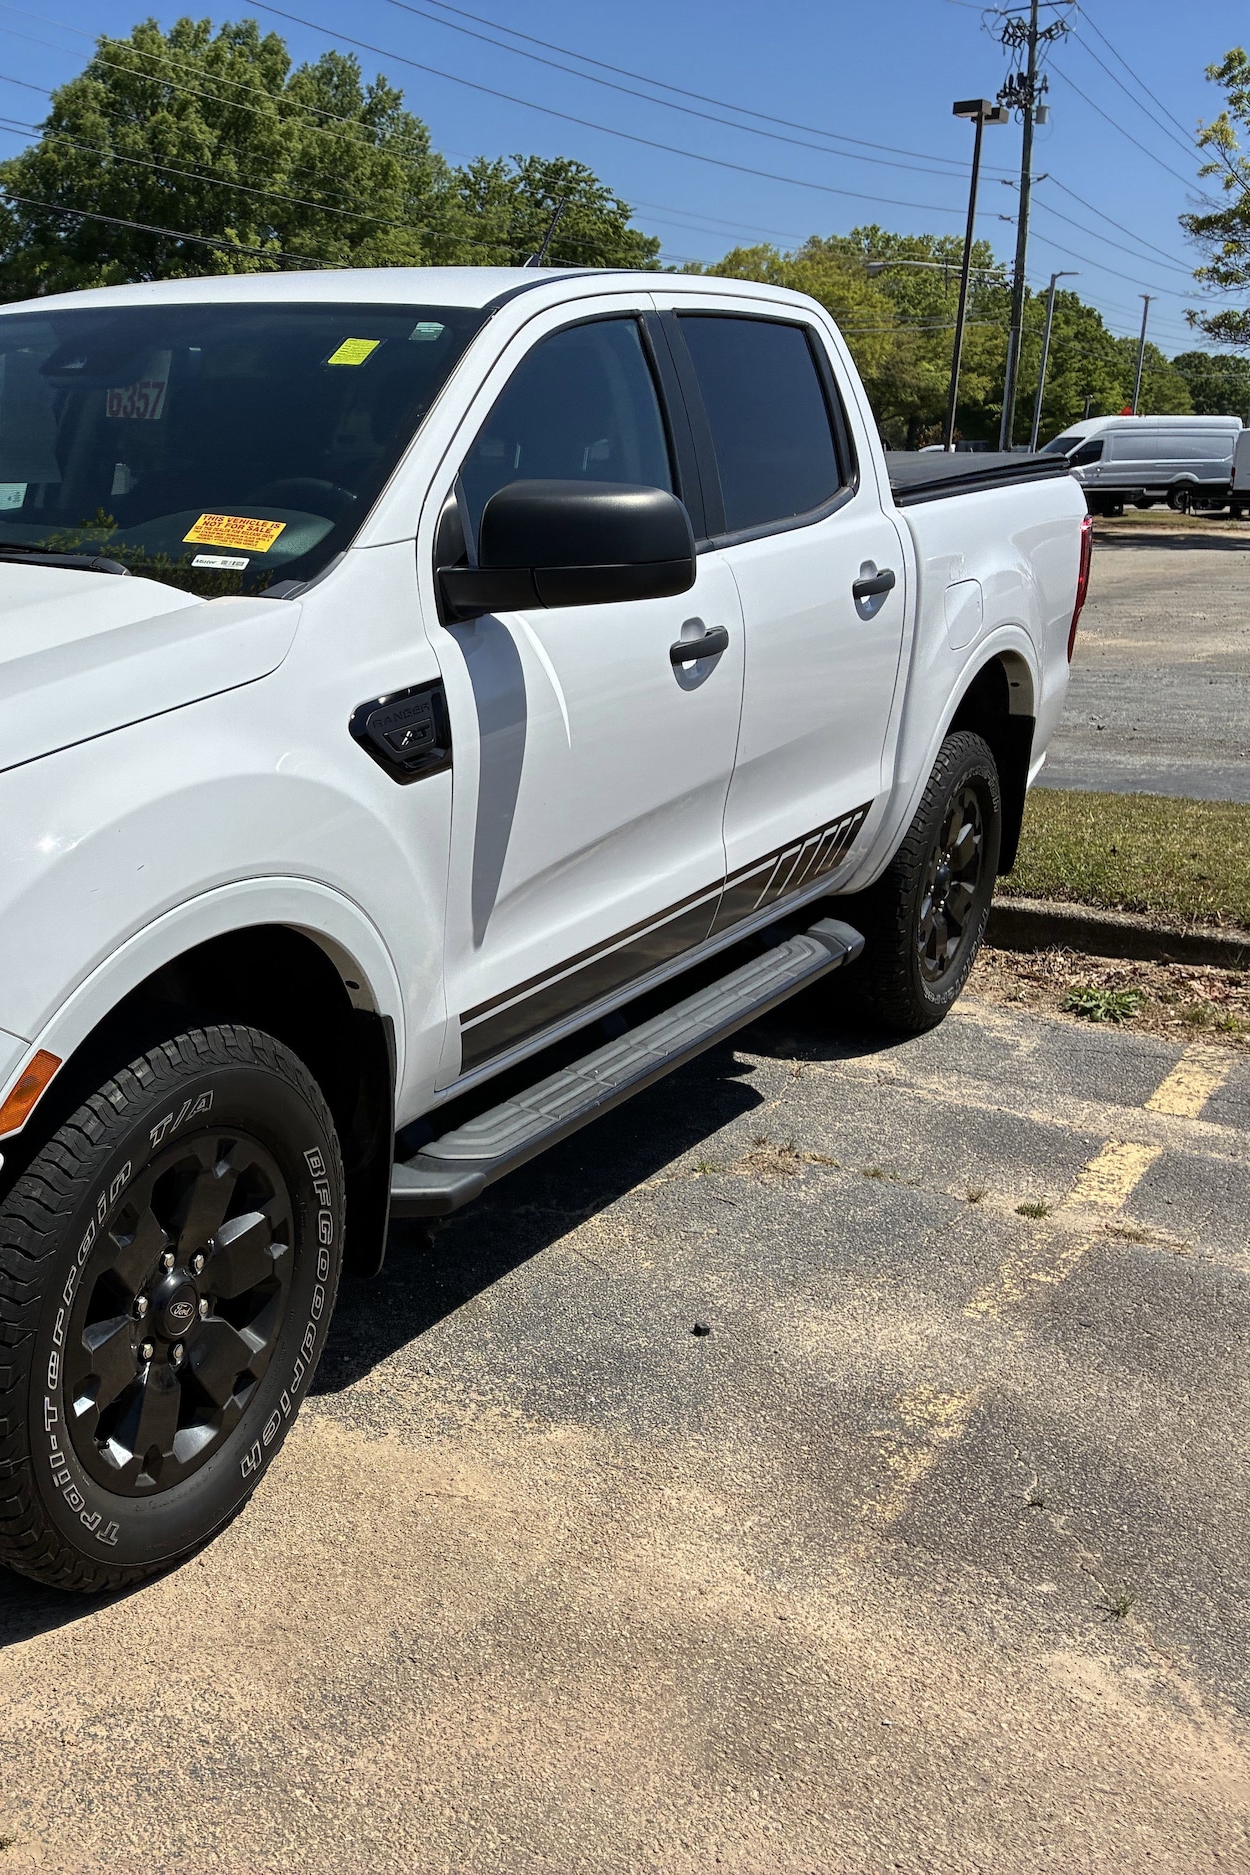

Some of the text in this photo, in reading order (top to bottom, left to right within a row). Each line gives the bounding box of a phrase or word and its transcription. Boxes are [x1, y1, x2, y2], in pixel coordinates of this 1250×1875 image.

[227, 517, 268, 527] VEHICLE
[372, 702, 430, 729] RANGER
[149, 1090, 214, 1148] T/A
[239, 1147, 333, 1478] BFGoodrich
